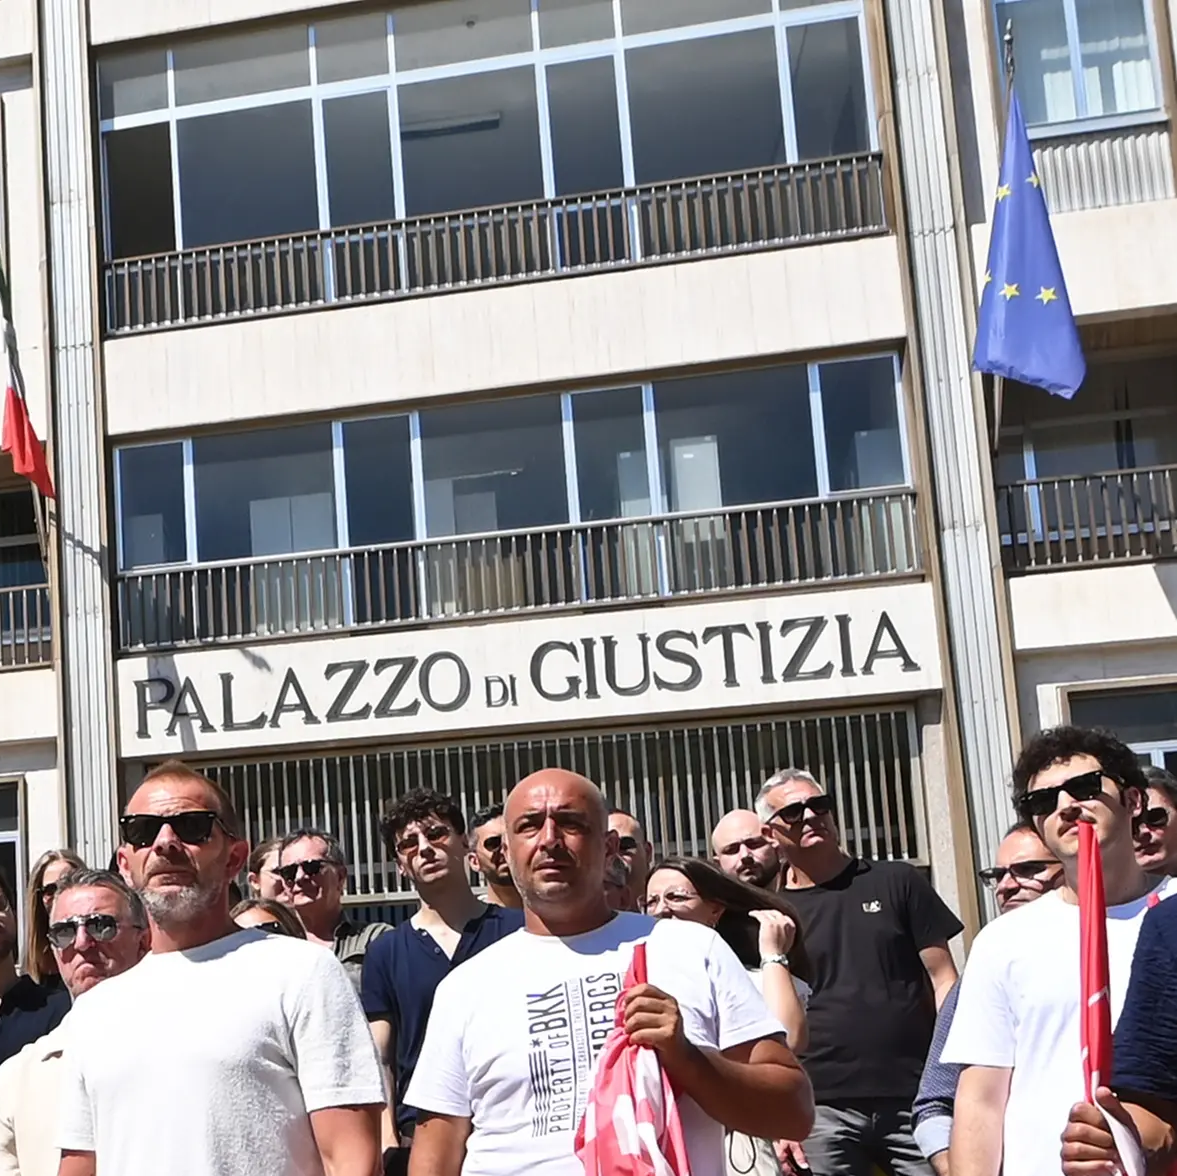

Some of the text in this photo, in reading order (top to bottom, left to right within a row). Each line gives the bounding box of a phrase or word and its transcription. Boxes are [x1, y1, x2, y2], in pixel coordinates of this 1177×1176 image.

[134, 611, 921, 740] PALAZZO DI GIUSTIZIA
[526, 982, 568, 1034] BKK
[548, 1033, 570, 1050] OF
